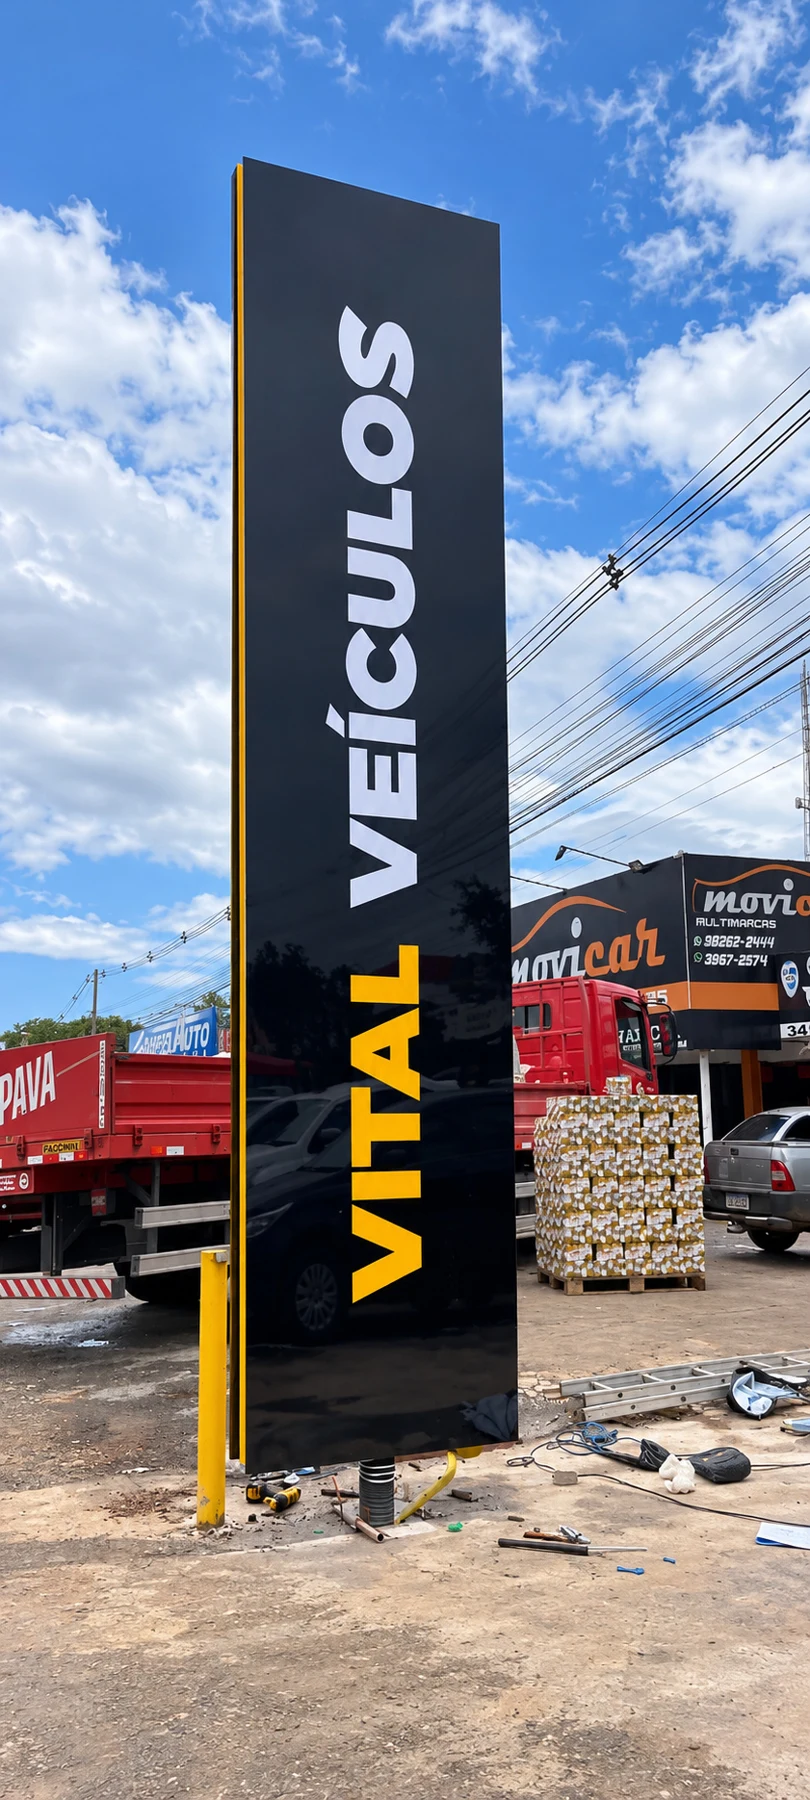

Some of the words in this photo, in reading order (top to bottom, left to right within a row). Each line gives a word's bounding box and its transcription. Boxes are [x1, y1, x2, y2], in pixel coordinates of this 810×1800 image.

[325, 305, 418, 908] VEÍCULOS
[703, 934, 775, 949] 98262-2444
[704, 953, 768, 967] 3967-2574
[787, 1024, 810, 1037] 34
[350, 944, 422, 1304] VITAL
